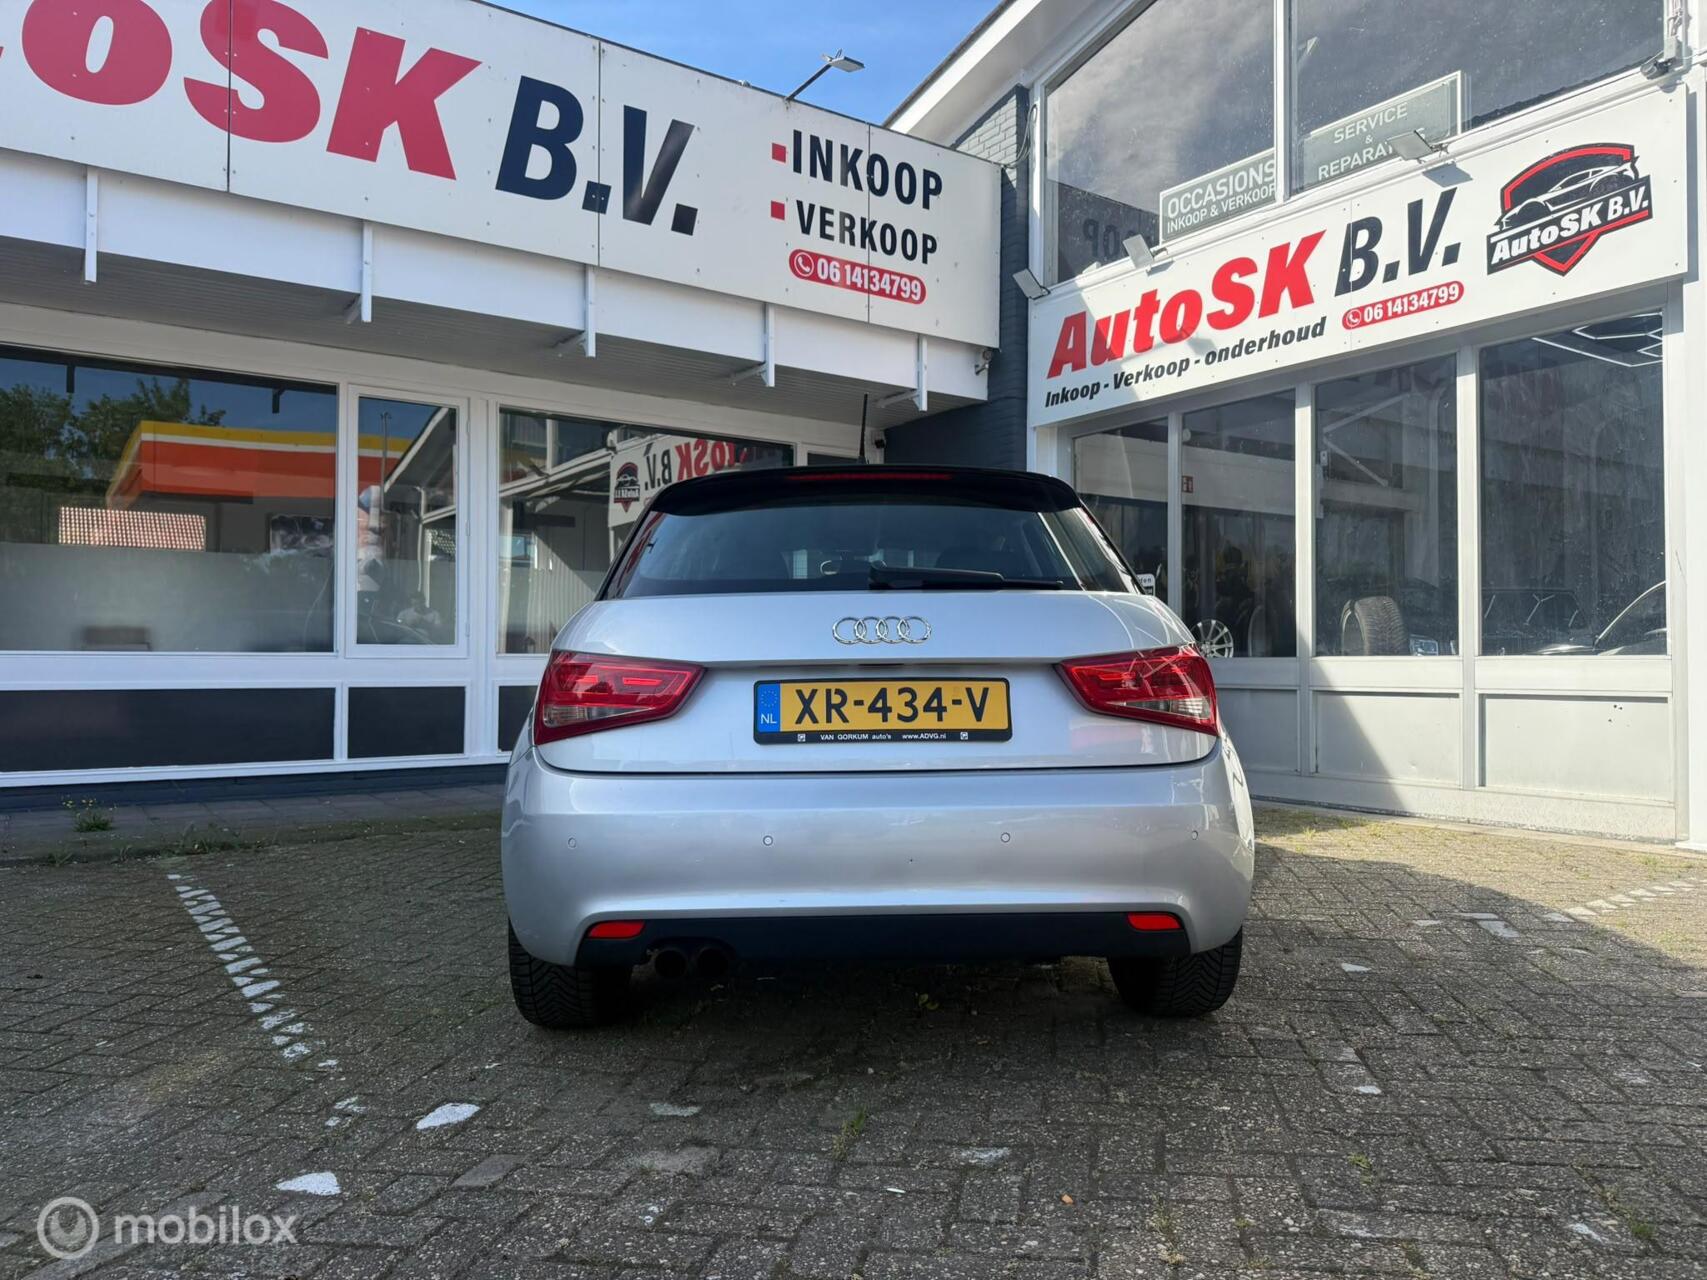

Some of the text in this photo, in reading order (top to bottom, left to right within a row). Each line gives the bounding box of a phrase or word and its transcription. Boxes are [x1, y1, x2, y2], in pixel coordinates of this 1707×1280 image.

[0, 0, 698, 235] oSK B.V.
[1334, 102, 1408, 143] SERVICE
[1365, 135, 1373, 144] &
[793, 129, 943, 210] INKOOP
[1167, 159, 1275, 218] OCCASIONS
[796, 200, 937, 264] VERKOOP
[1167, 207, 1207, 233] INKOOP
[1210, 204, 1219, 217] &
[1491, 186, 1649, 265] AutoSK B.V.
[817, 258, 921, 301] 06 14134799
[1046, 186, 1461, 379] AutoSK B.V.
[1363, 283, 1460, 324] 06 14134799
[1204, 316, 1327, 366] onderhoud
[760, 713, 777, 724] NL
[794, 687, 990, 725] XR-434-V
[820, 733, 834, 741] VAN
